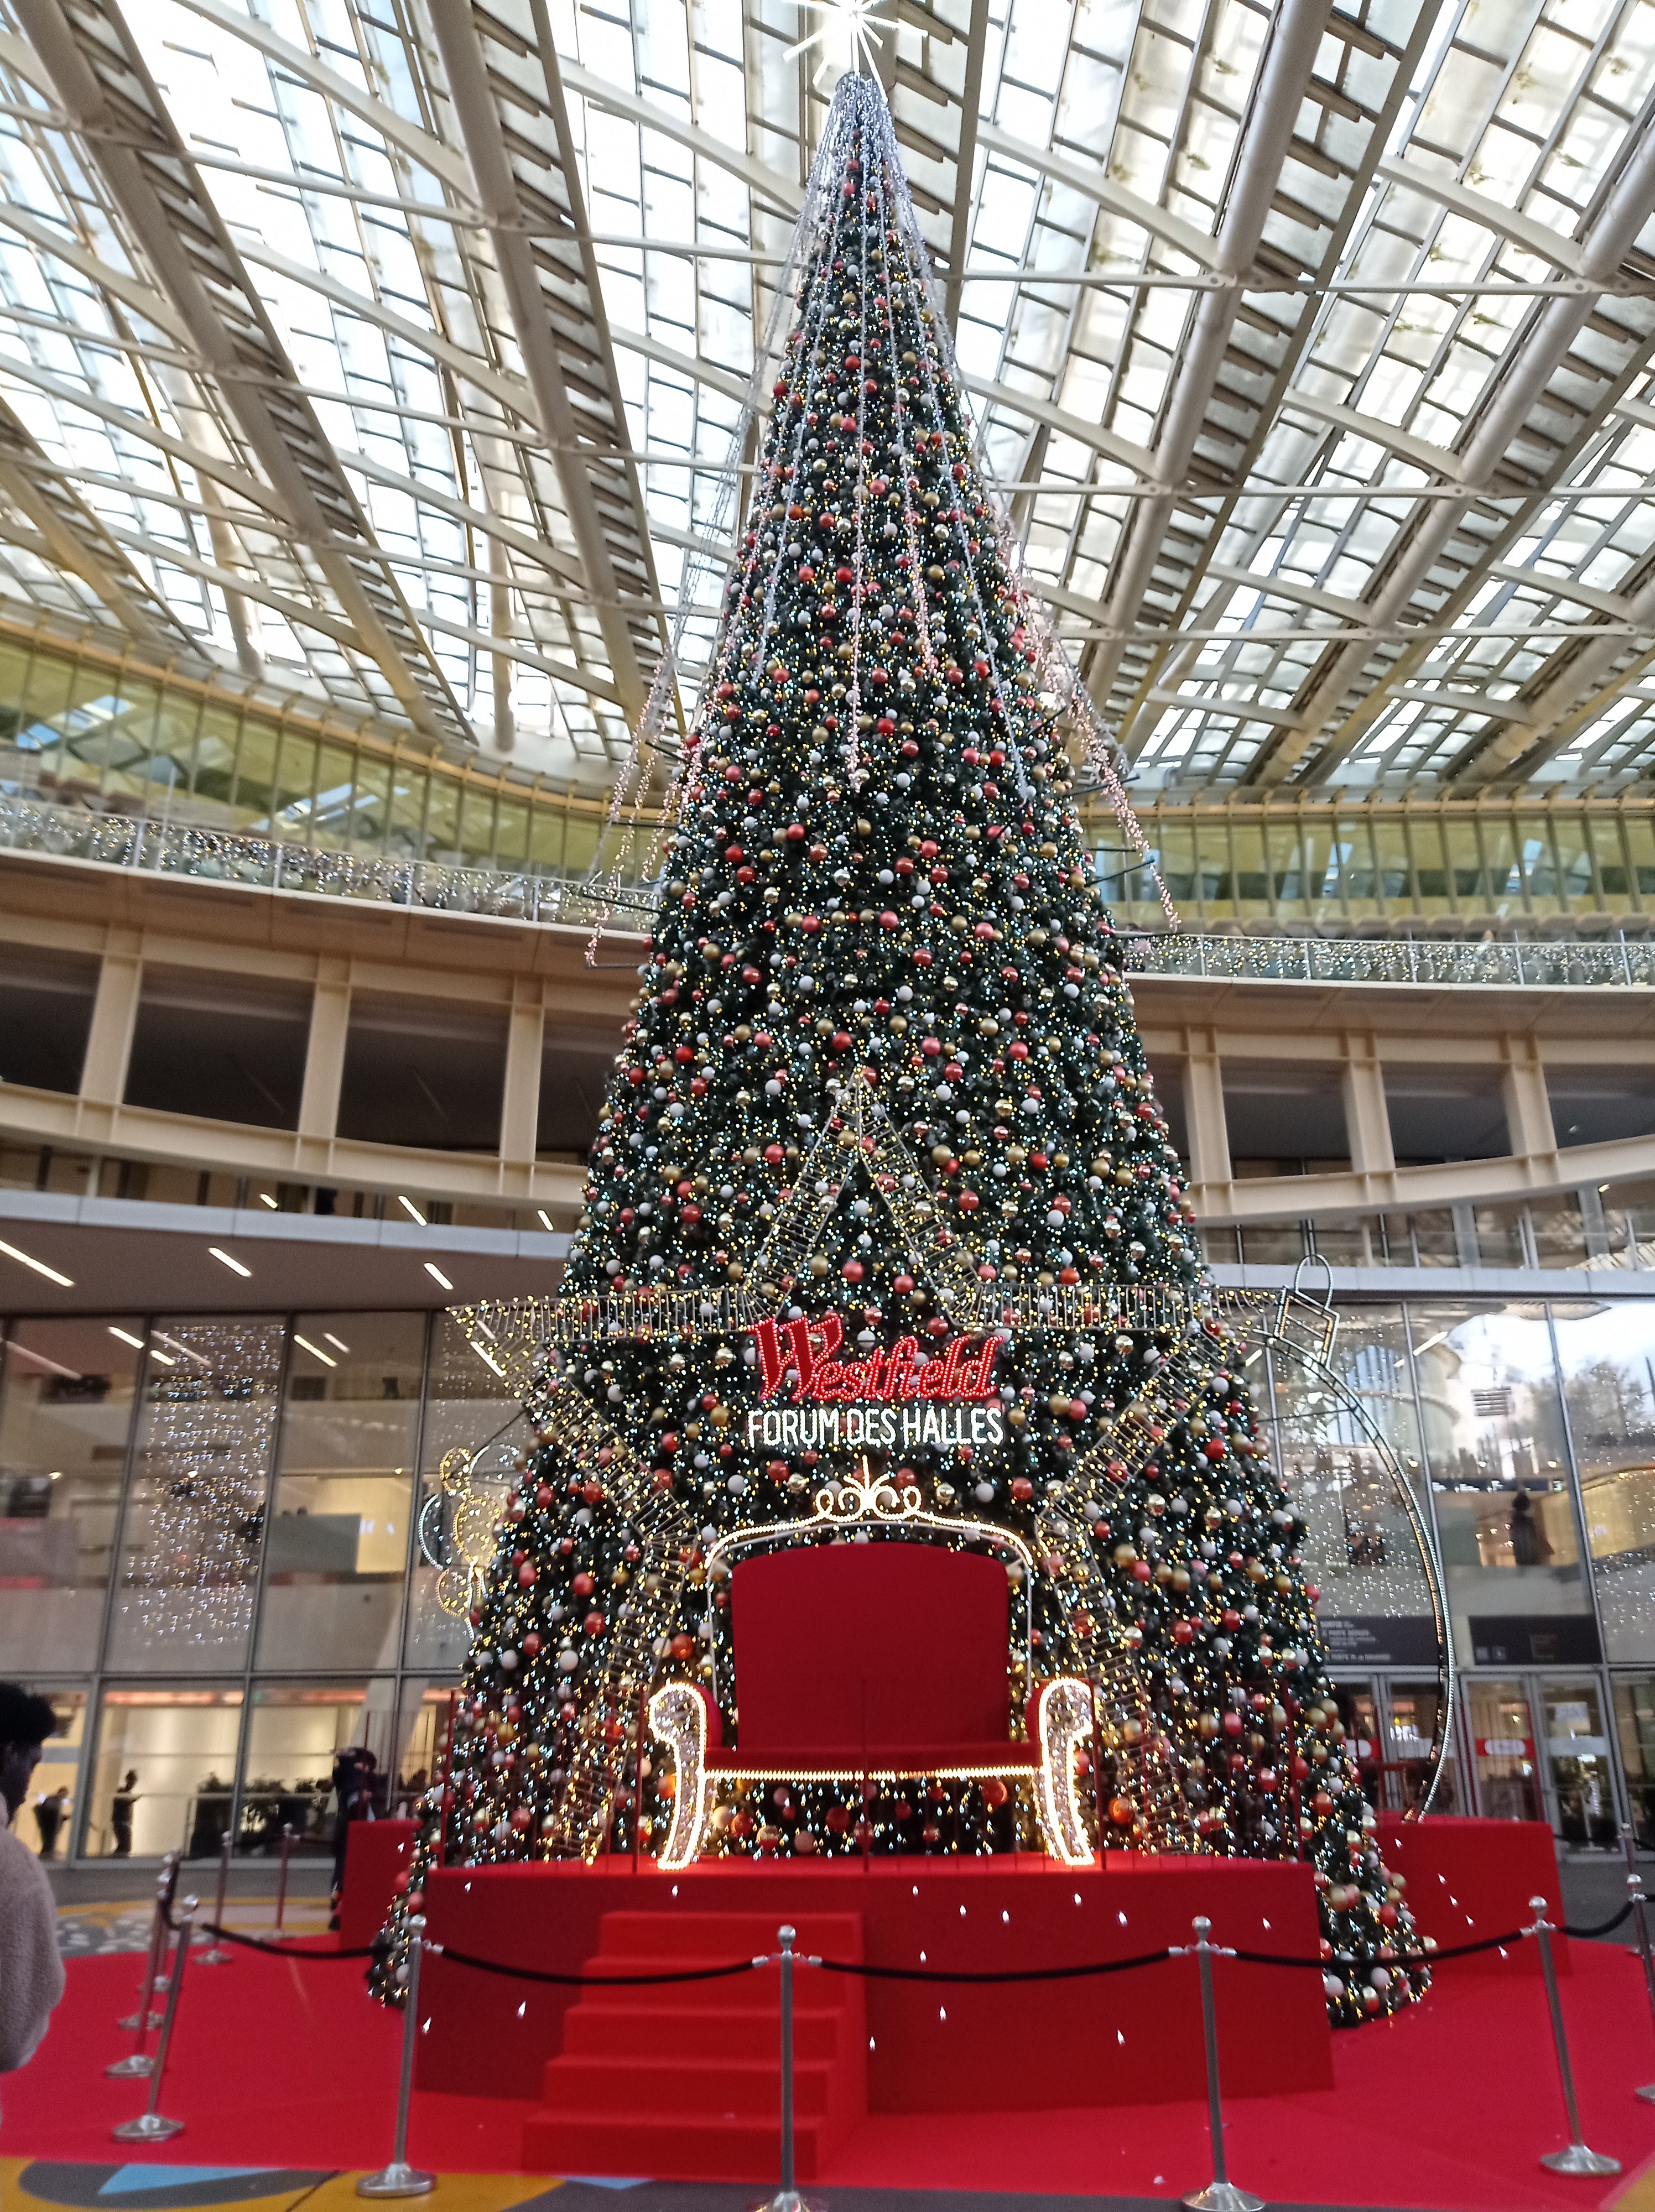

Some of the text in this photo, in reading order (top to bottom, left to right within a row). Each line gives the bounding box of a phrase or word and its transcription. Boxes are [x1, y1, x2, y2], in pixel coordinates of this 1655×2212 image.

[747, 1316, 1005, 1401] Westfield
[748, 1408, 1003, 1447] FORUM DES HALLES
